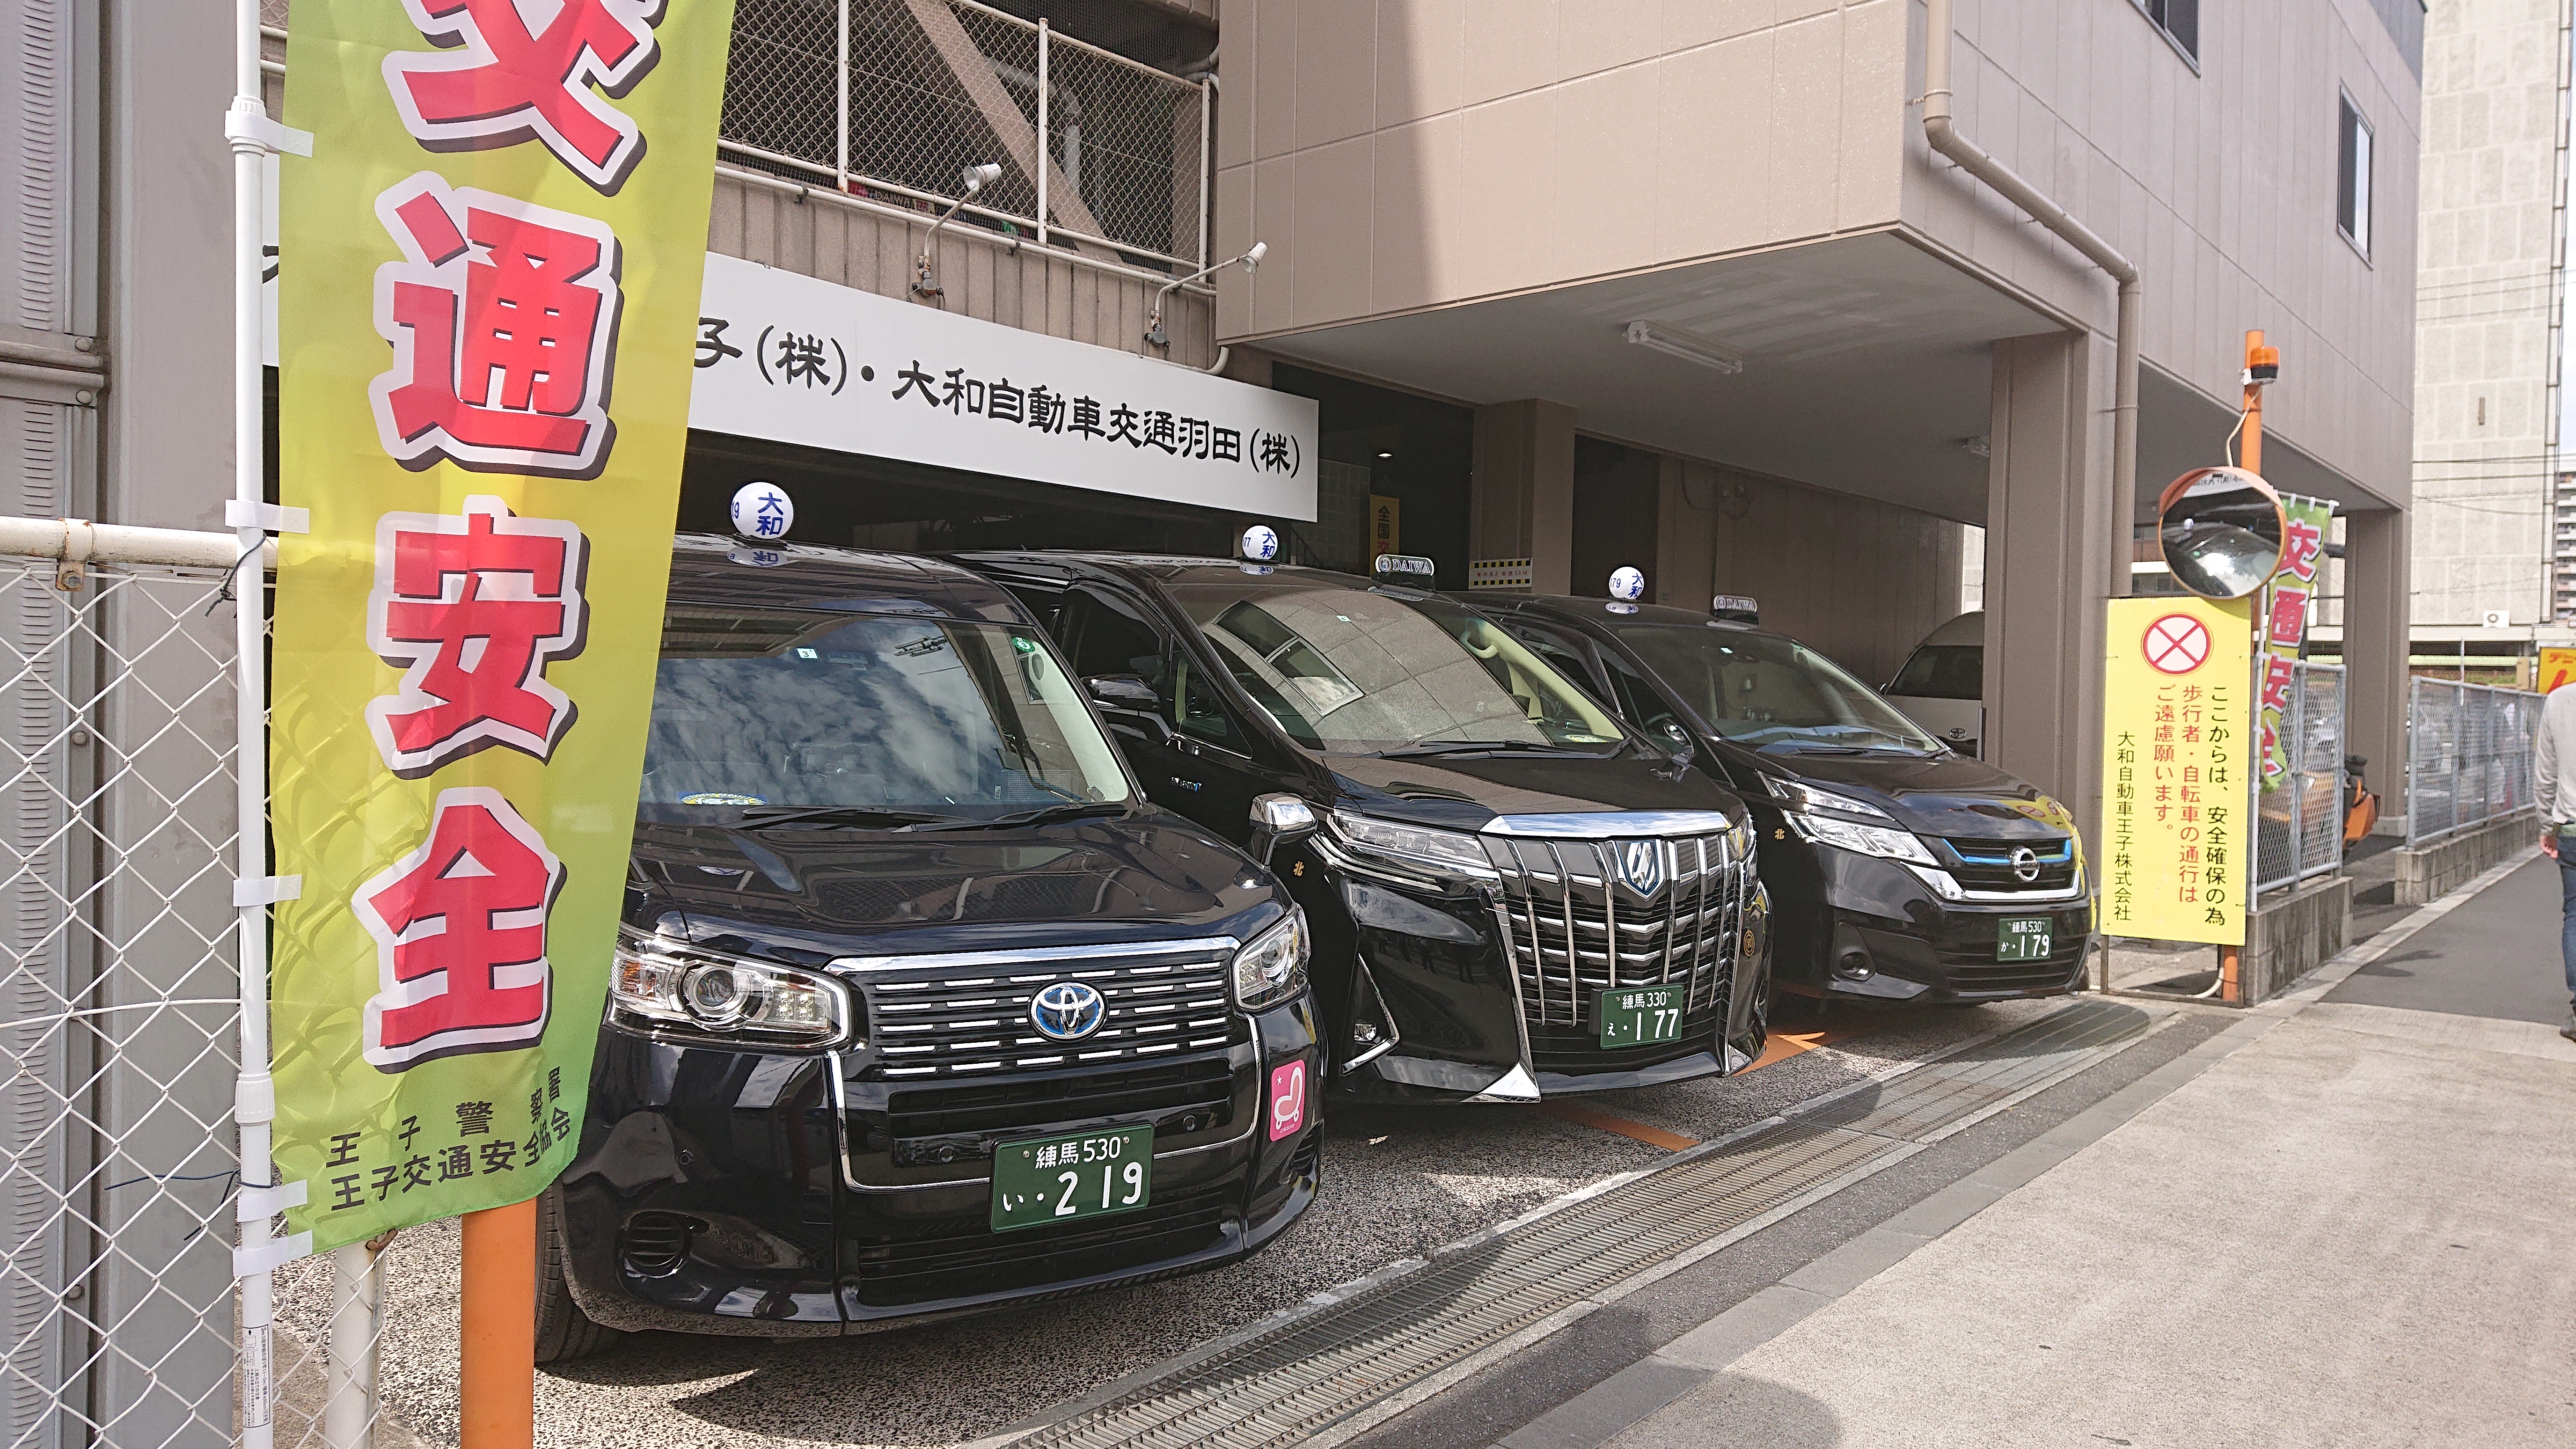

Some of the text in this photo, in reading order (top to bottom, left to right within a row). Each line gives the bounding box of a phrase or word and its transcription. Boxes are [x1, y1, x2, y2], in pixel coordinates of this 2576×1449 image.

[755, 492, 783, 535] 大和
[351, 0, 664, 1074] 交通安全
[1260, 531, 1276, 557] 大和
[1392, 559, 1431, 573] DAIWA
[1610, 578, 1621, 588] 179
[1628, 572, 1643, 598] 大和
[1726, 598, 1755, 611] DAIWA
[2154, 685, 2177, 831] ご遠慮願います。
[2179, 685, 2203, 903] 歩行者・自転車の通行は
[1774, 828, 1785, 840] 北
[2114, 731, 2135, 921] 大和自動車王子株式会社
[1293, 861, 1304, 877] 北
[331, 1106, 570, 1211] 王子交通安全協会
